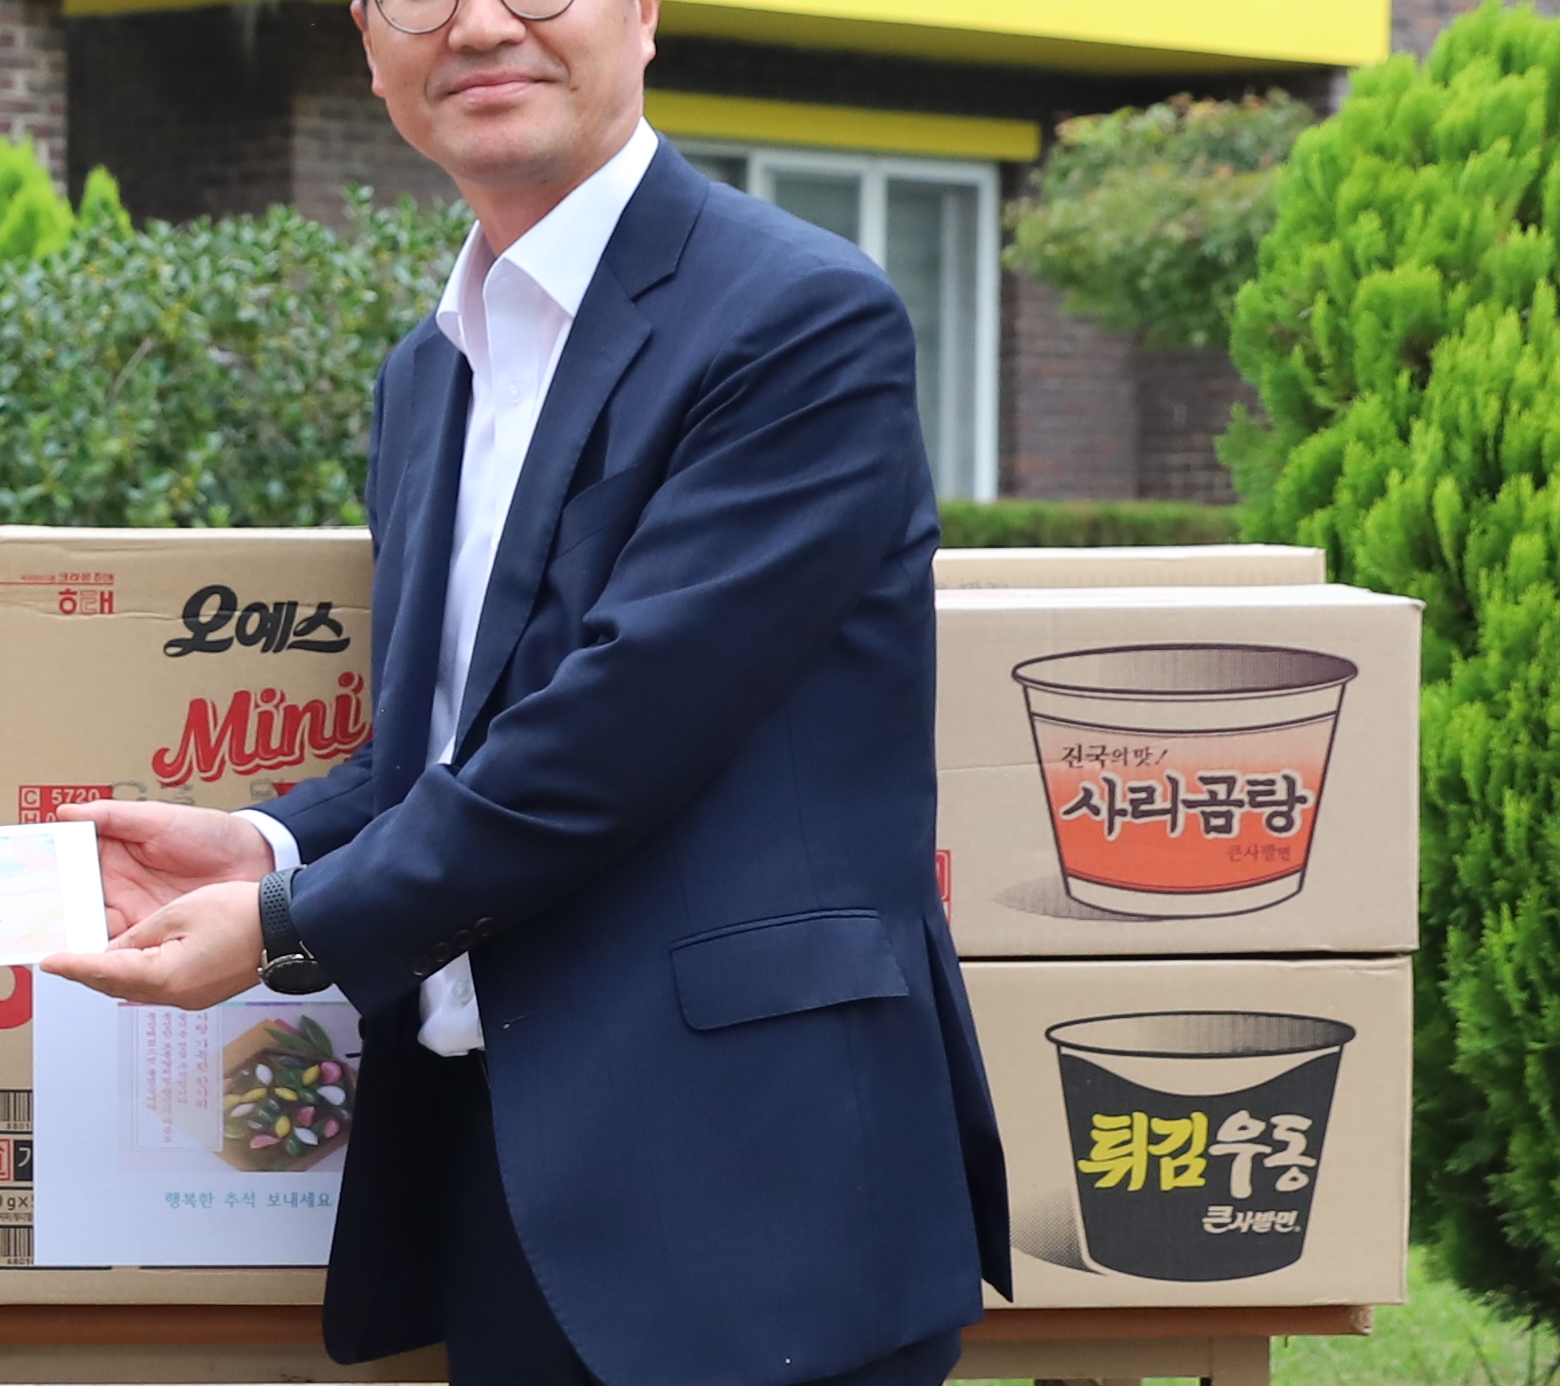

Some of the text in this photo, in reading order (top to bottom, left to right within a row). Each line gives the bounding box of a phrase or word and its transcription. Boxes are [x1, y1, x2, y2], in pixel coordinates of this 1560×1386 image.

[163, 585, 351, 657] 오예스
[152, 671, 372, 786] Mini
[1061, 743, 1129, 769] 진국의
[51, 789, 100, 805] 5720
[1060, 772, 1310, 837] 사리곰탕
[1228, 843, 1292, 862] 큰사발면
[1077, 1109, 1317, 1199] 튀김우동
[164, 1191, 333, 1209] 행복한 추석 보내세요
[1201, 1205, 1299, 1234] 큰사발면
